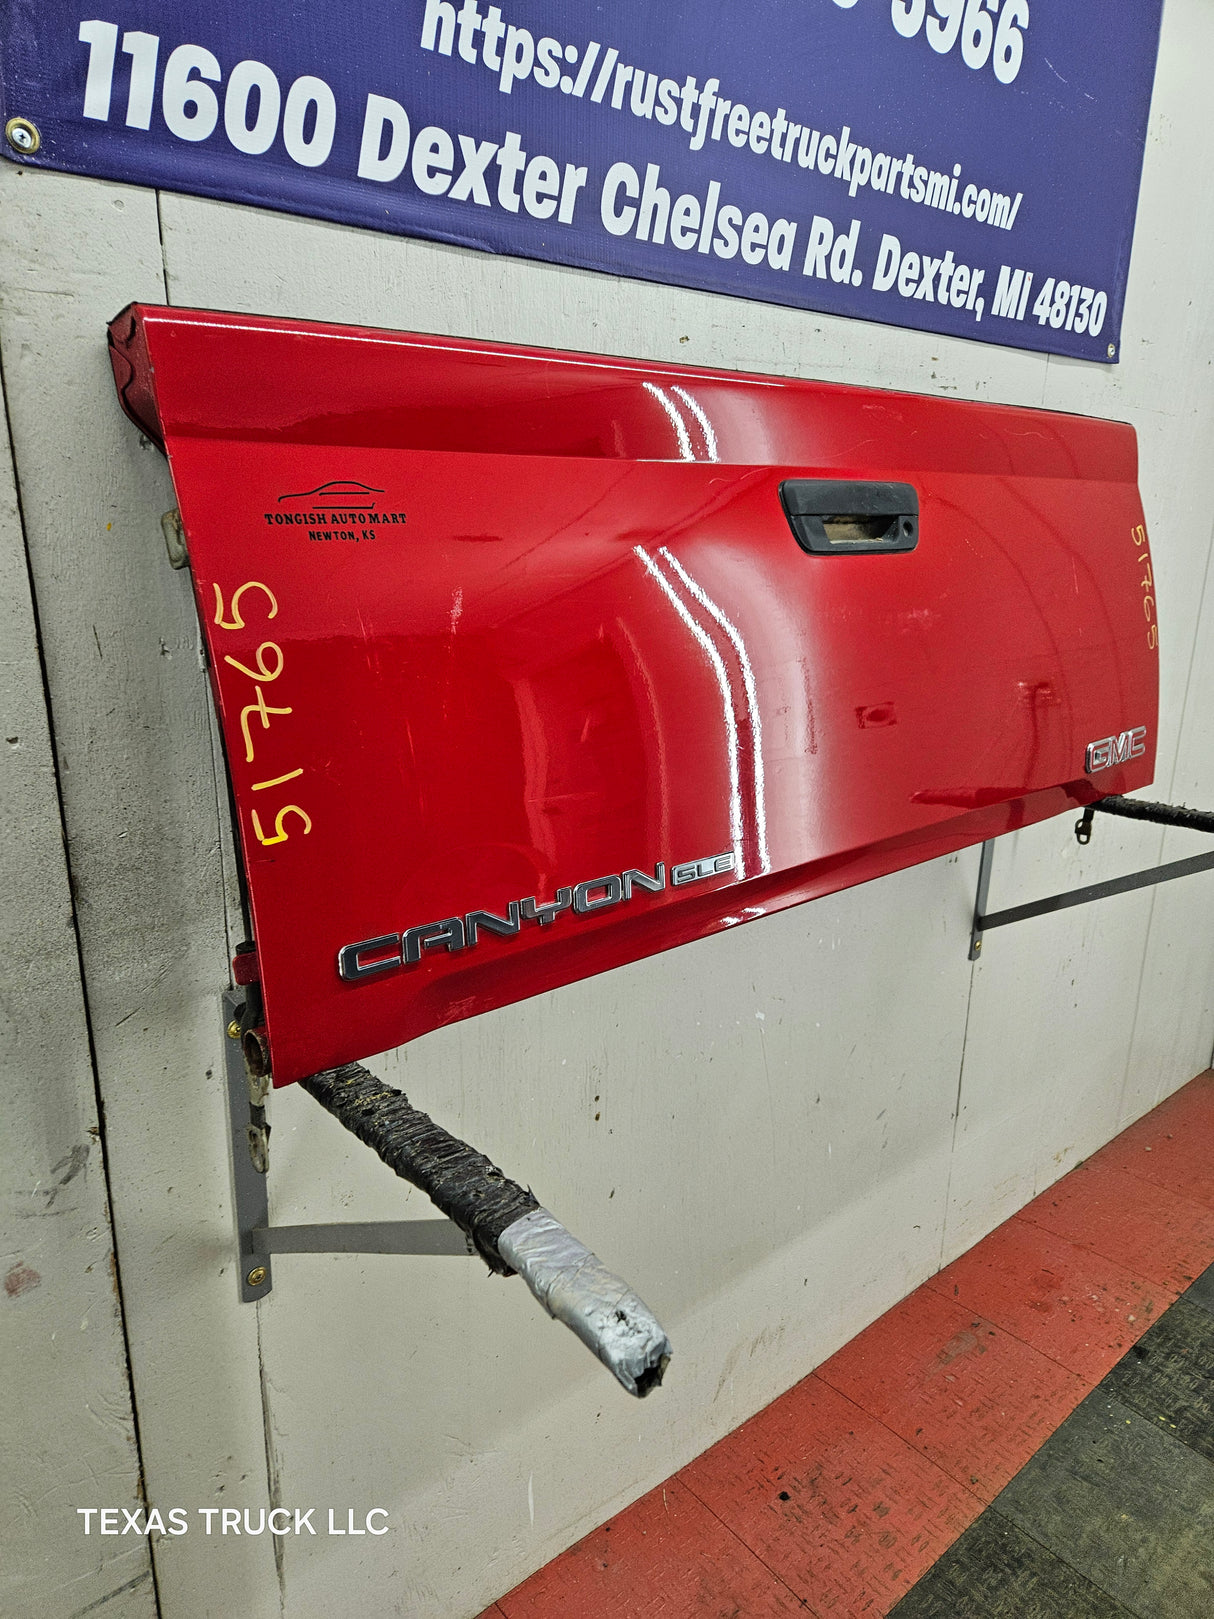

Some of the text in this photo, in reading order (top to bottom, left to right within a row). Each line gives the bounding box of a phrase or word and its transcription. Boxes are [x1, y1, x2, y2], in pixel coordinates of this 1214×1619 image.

[78, 19, 1107, 337] 11600 Dexter Chelsea Rd. Dexter, MI 48130
[420, 0, 1022, 230] https://rustfreetruckpartsmi.com/
[264, 513, 407, 525] TONGISH AUTO MART
[308, 529, 376, 542] NEWTON, KS
[213, 581, 312, 846] 51765
[1085, 725, 1147, 774] GMC
[338, 853, 733, 981] CANYON SLE
